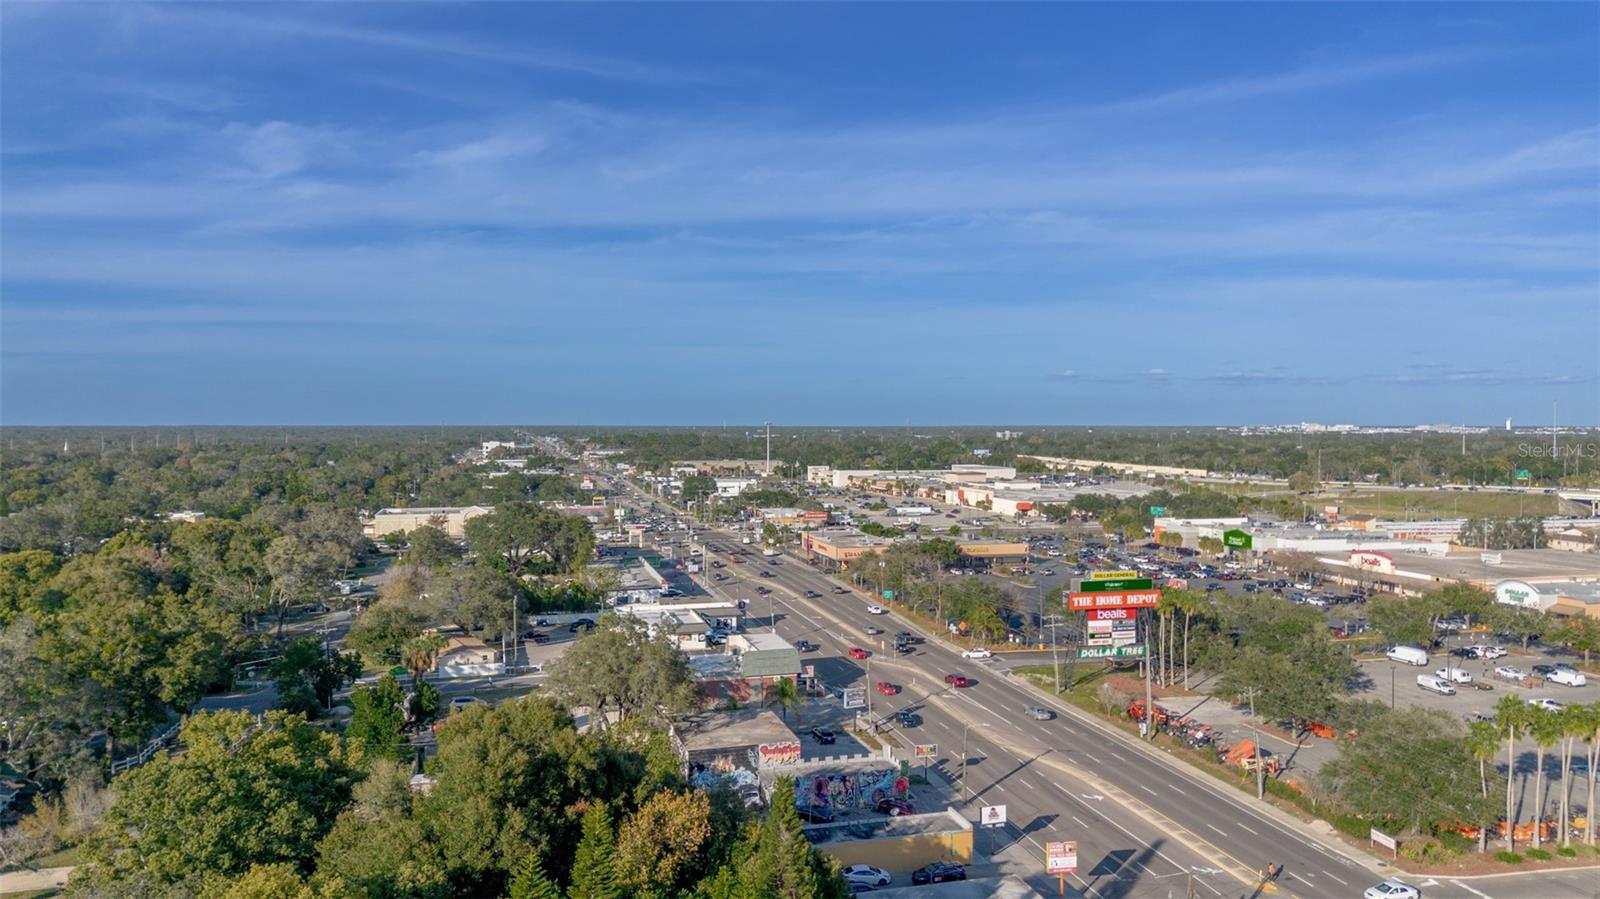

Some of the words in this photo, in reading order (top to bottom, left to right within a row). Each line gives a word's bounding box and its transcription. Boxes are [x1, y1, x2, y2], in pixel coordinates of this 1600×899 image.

[1072, 597, 1093, 607] THE
[1096, 595, 1123, 605] HOME
[1126, 594, 1158, 605] DEPOT
[1097, 608, 1127, 619] bealls
[1081, 648, 1117, 658] DOLLAR
[1121, 646, 1144, 656] TREE
